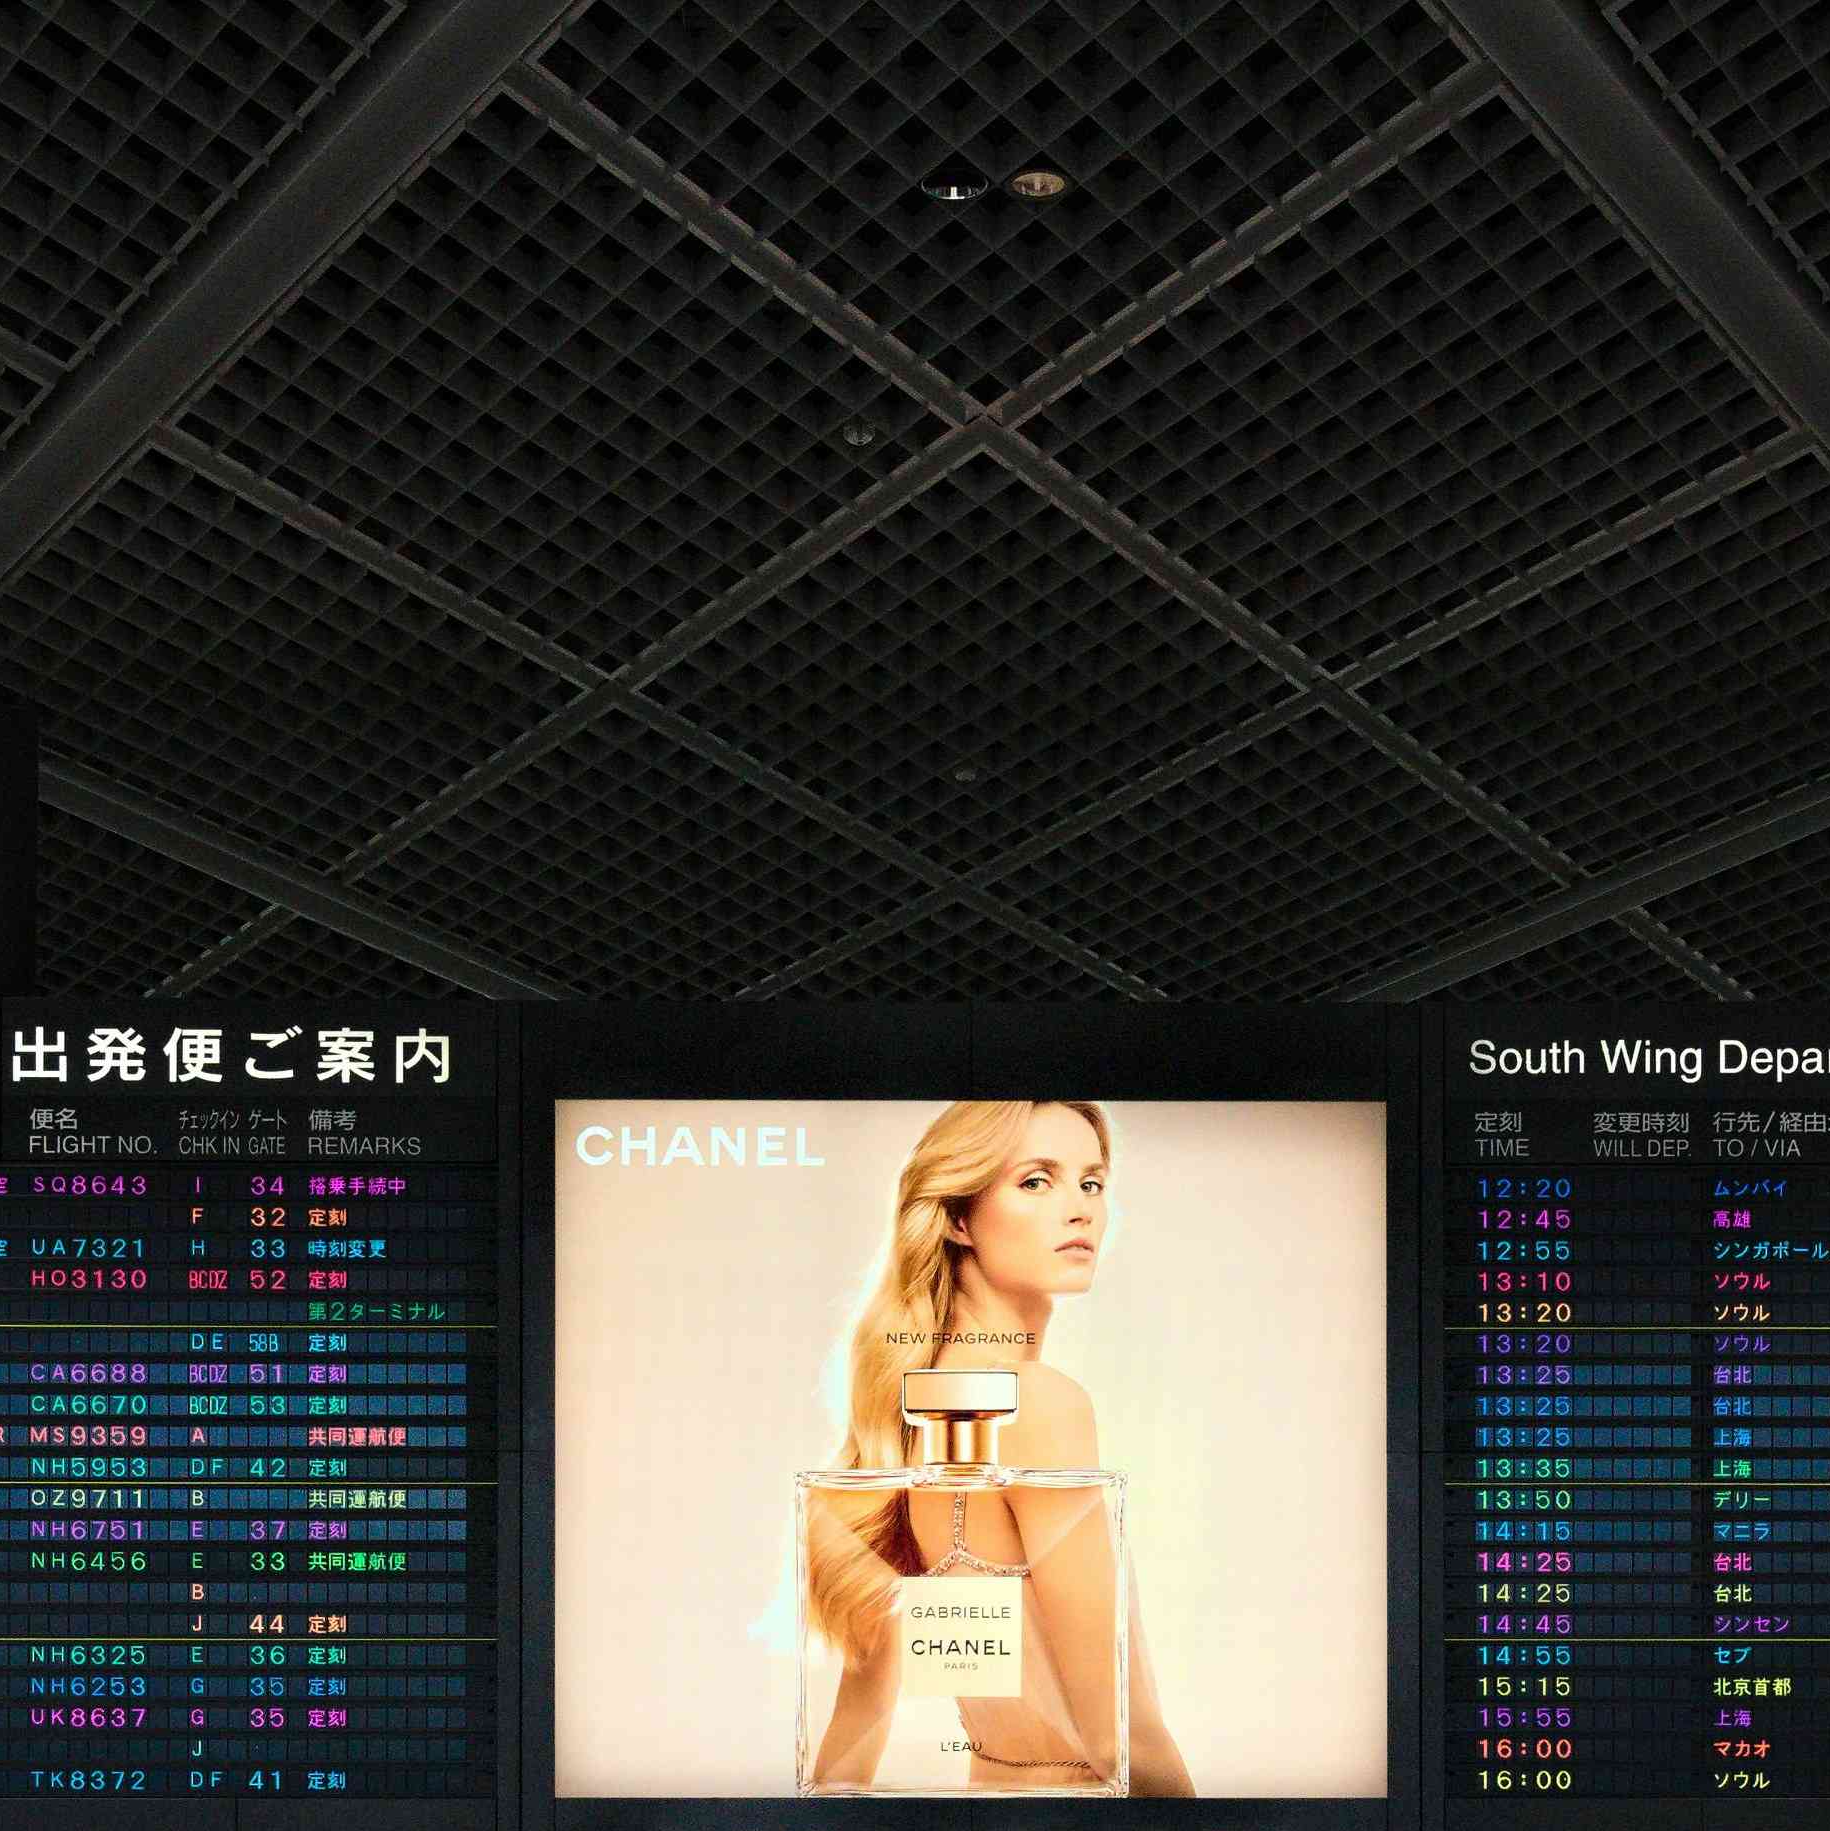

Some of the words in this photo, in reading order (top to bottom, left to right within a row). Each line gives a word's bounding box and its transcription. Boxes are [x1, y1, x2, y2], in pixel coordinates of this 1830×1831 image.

[1469, 1039, 1585, 1075] South
[1600, 1039, 1702, 1084] Wing
[248, 1108, 288, 1131] ゲート
[308, 1108, 357, 1132] 備考
[178, 1135, 218, 1155] CHK
[222, 1136, 240, 1155] IN
[247, 1135, 286, 1156] GATE
[307, 1136, 422, 1156] REMARKS
[575, 1125, 827, 1167] CHANEL
[33, 1175, 147, 1196] SQ8643
[251, 1176, 284, 1196] 34
[309, 1176, 406, 1196] 搭乗手続中
[31, 1238, 143, 1259] UA7321
[250, 1238, 286, 1259] 33
[307, 1239, 386, 1259] 時刻変更
[31, 1268, 147, 1289] HO3130
[249, 1269, 286, 1290] 52
[308, 1270, 348, 1290] 定刻
[1479, 1302, 1571, 1323] 13:20
[1714, 1303, 1771, 1322] ソウル
[885, 1331, 927, 1346] NEW
[931, 1331, 1037, 1346] FRAGRANCE
[30, 1425, 146, 1446] MS9359
[308, 1427, 406, 1447] 共同運航便
[910, 1604, 1012, 1621] GABRIELLE
[910, 1638, 1011, 1657] CHANEL
[943, 1661, 979, 1671] PARIS
[1478, 1676, 1571, 1697] 15:15
[1713, 1677, 1792, 1697] 北京首都
[939, 1738, 983, 1754] L'EAU
[1479, 1738, 1572, 1759] 16:00
[1713, 1739, 1771, 1758] マカオ
